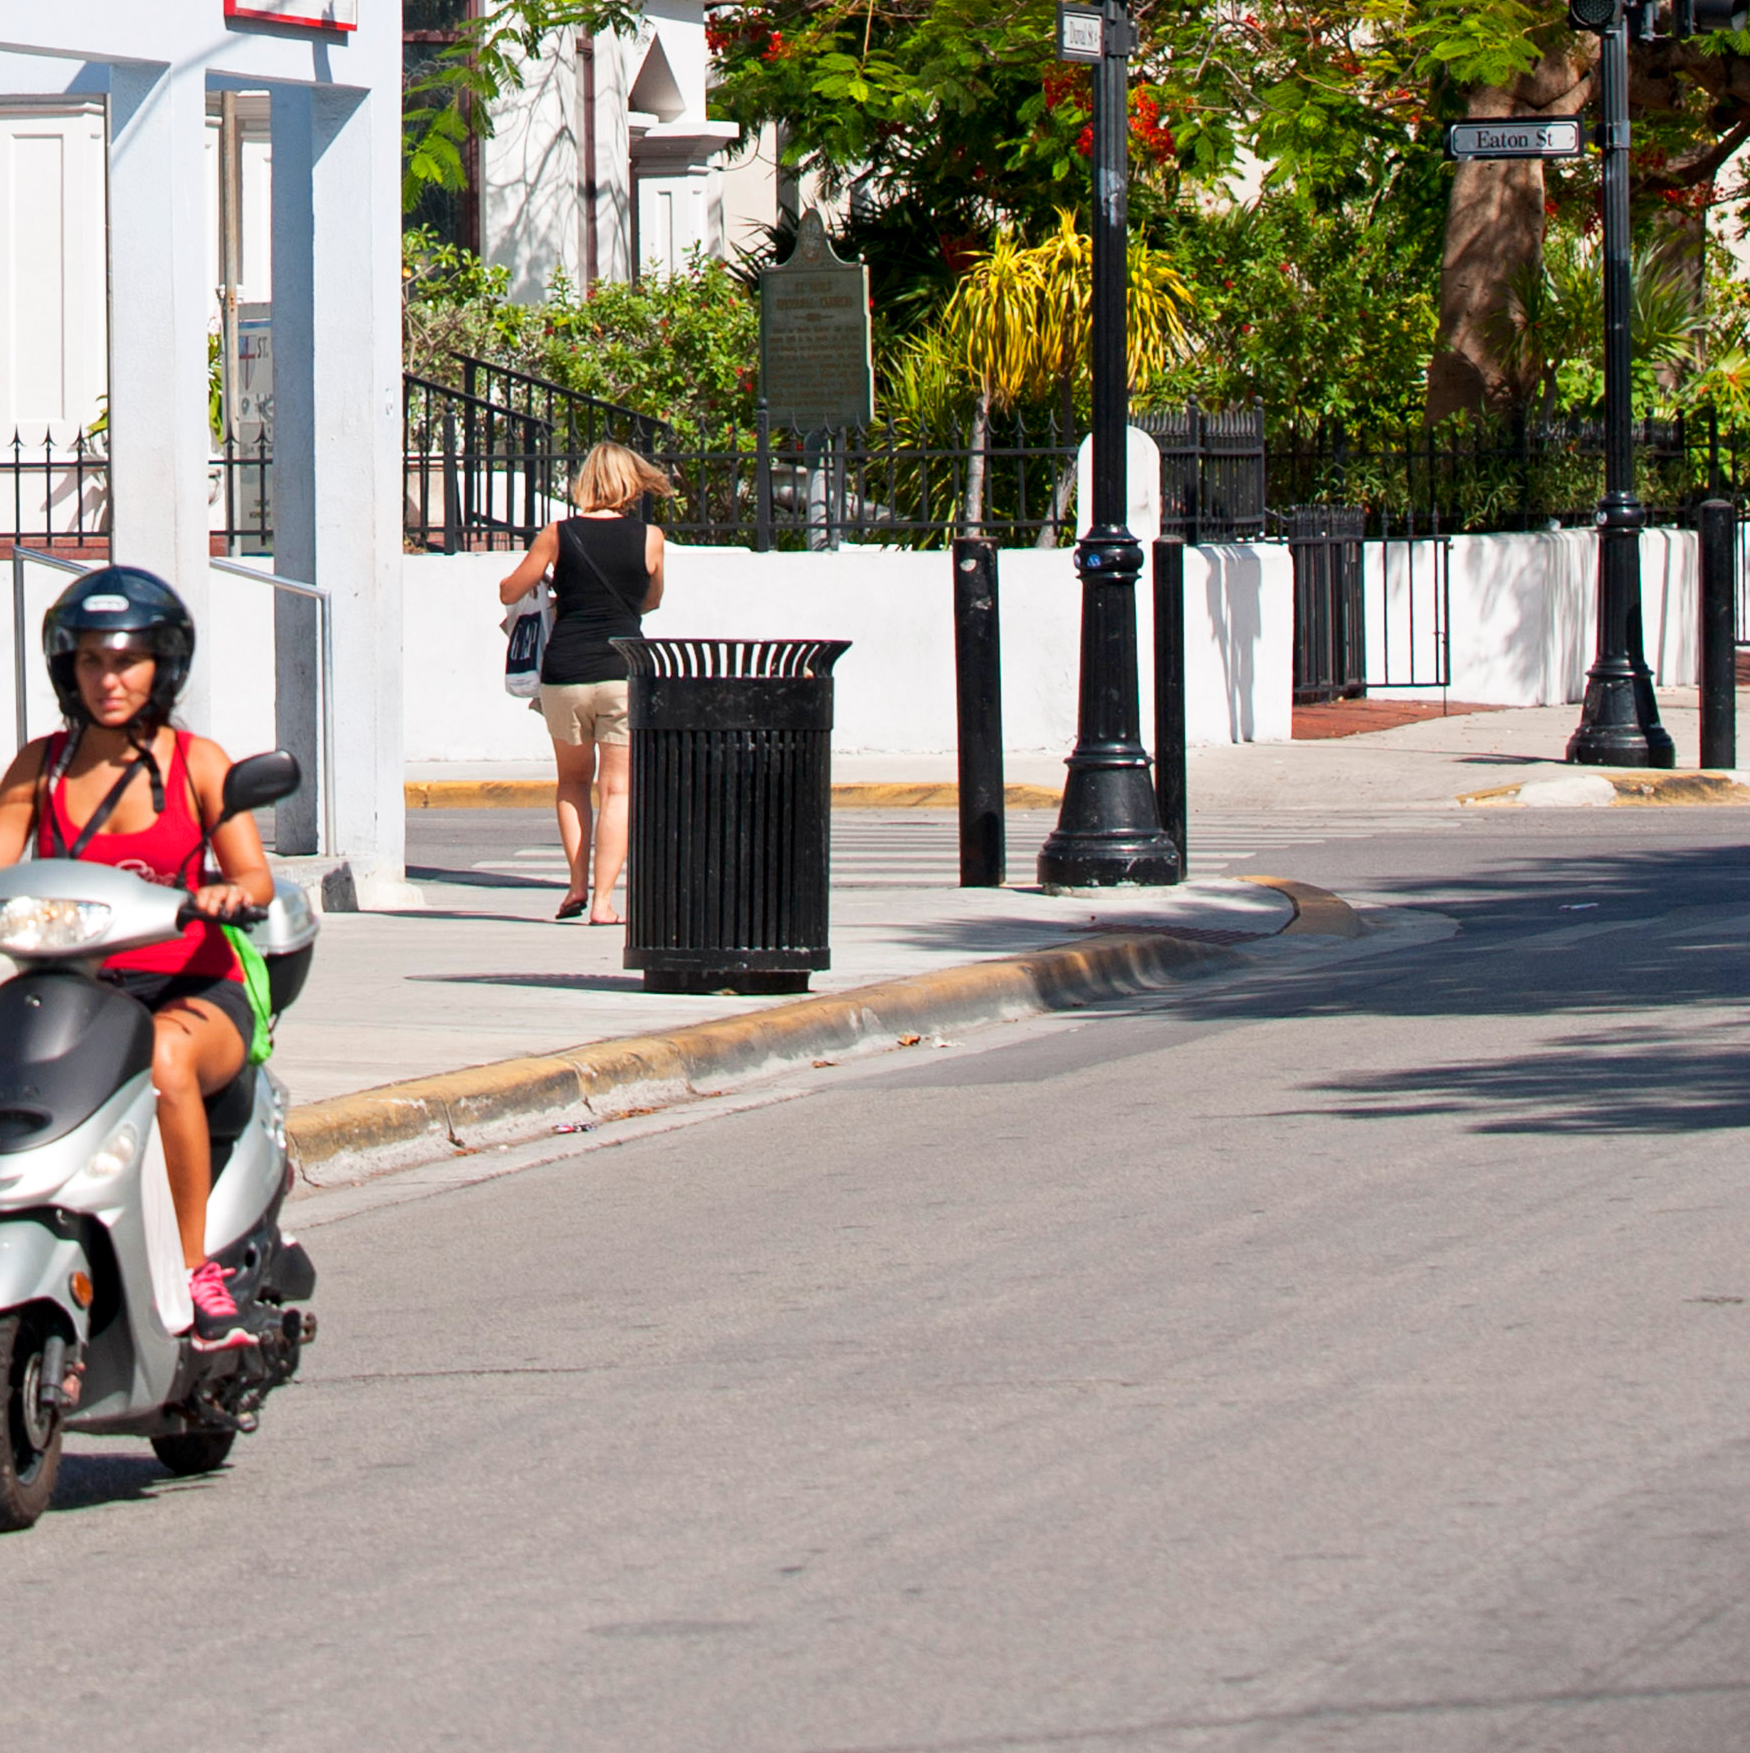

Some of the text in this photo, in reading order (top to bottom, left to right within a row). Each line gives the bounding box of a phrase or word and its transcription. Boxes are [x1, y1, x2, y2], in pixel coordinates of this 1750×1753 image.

[1069, 20, 1088, 46] Duval
[1476, 129, 1553, 149] Eaton St
